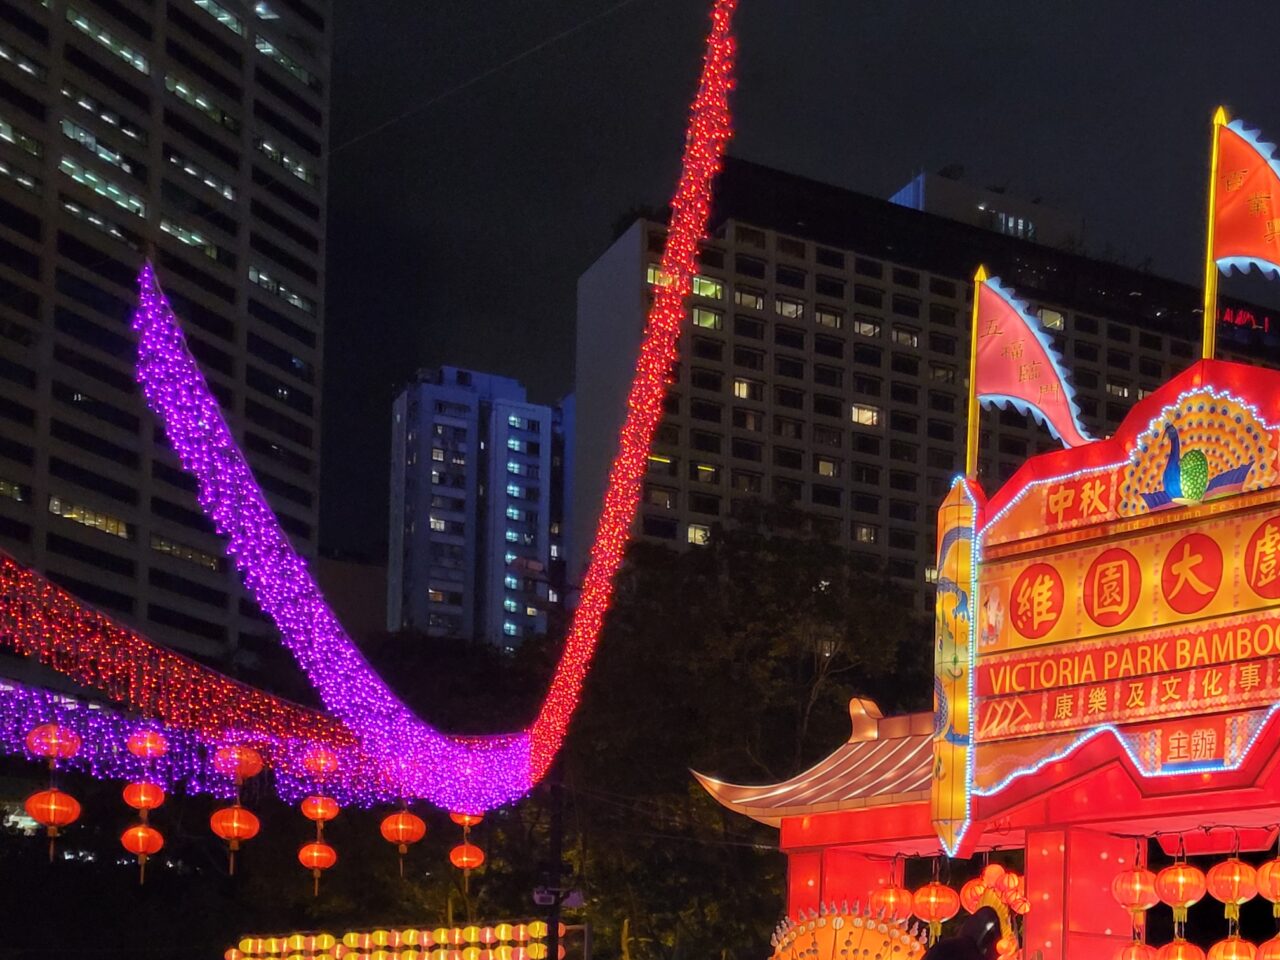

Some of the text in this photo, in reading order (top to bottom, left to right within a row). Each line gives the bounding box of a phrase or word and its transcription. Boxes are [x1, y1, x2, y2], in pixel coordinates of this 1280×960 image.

[980, 319, 1059, 404] 五福臨門
[1049, 480, 1107, 527] 中秋
[990, 654, 1096, 695] VICTORIA
[1104, 642, 1170, 681] PARK
[1168, 729, 1216, 761] 主辦
